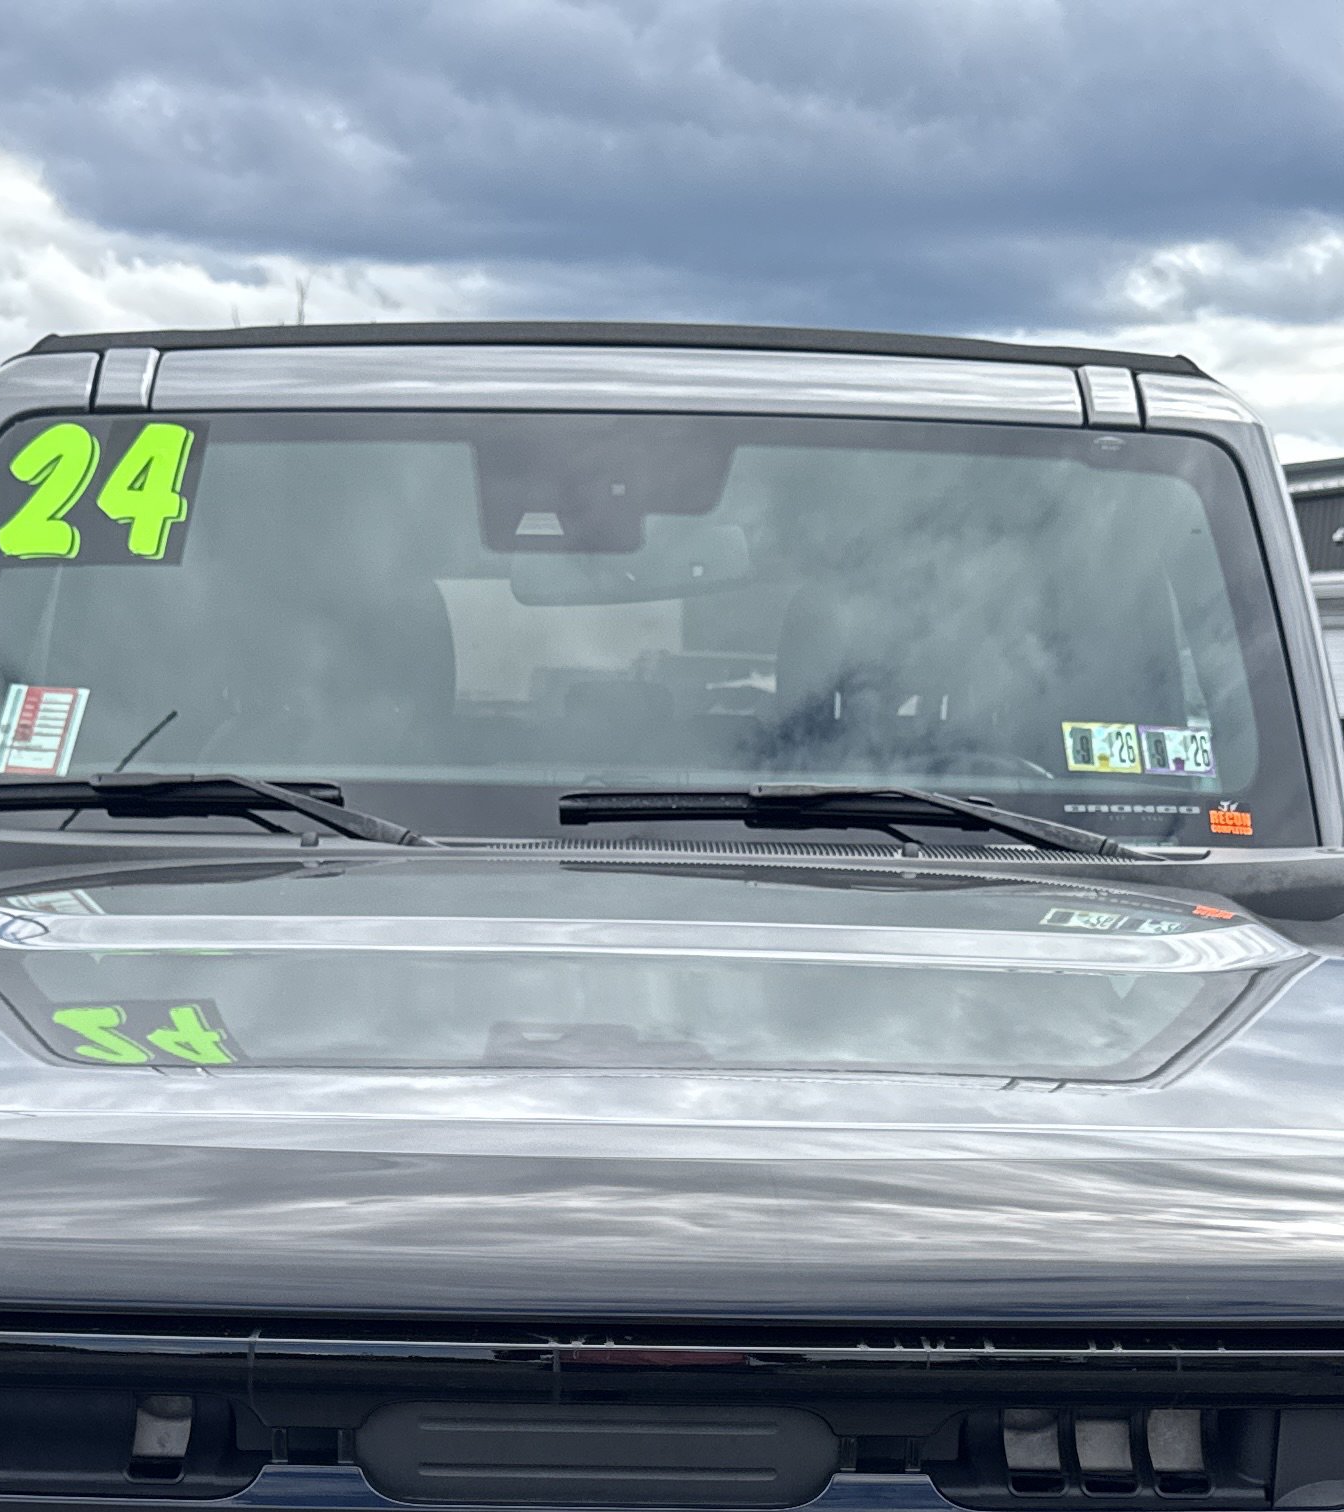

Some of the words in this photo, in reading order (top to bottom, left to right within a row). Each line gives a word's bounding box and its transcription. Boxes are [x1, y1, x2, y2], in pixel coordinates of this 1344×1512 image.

[1116, 731, 1136, 763] 26
[1191, 735, 1210, 767] 26
[1209, 810, 1252, 826] RECON
